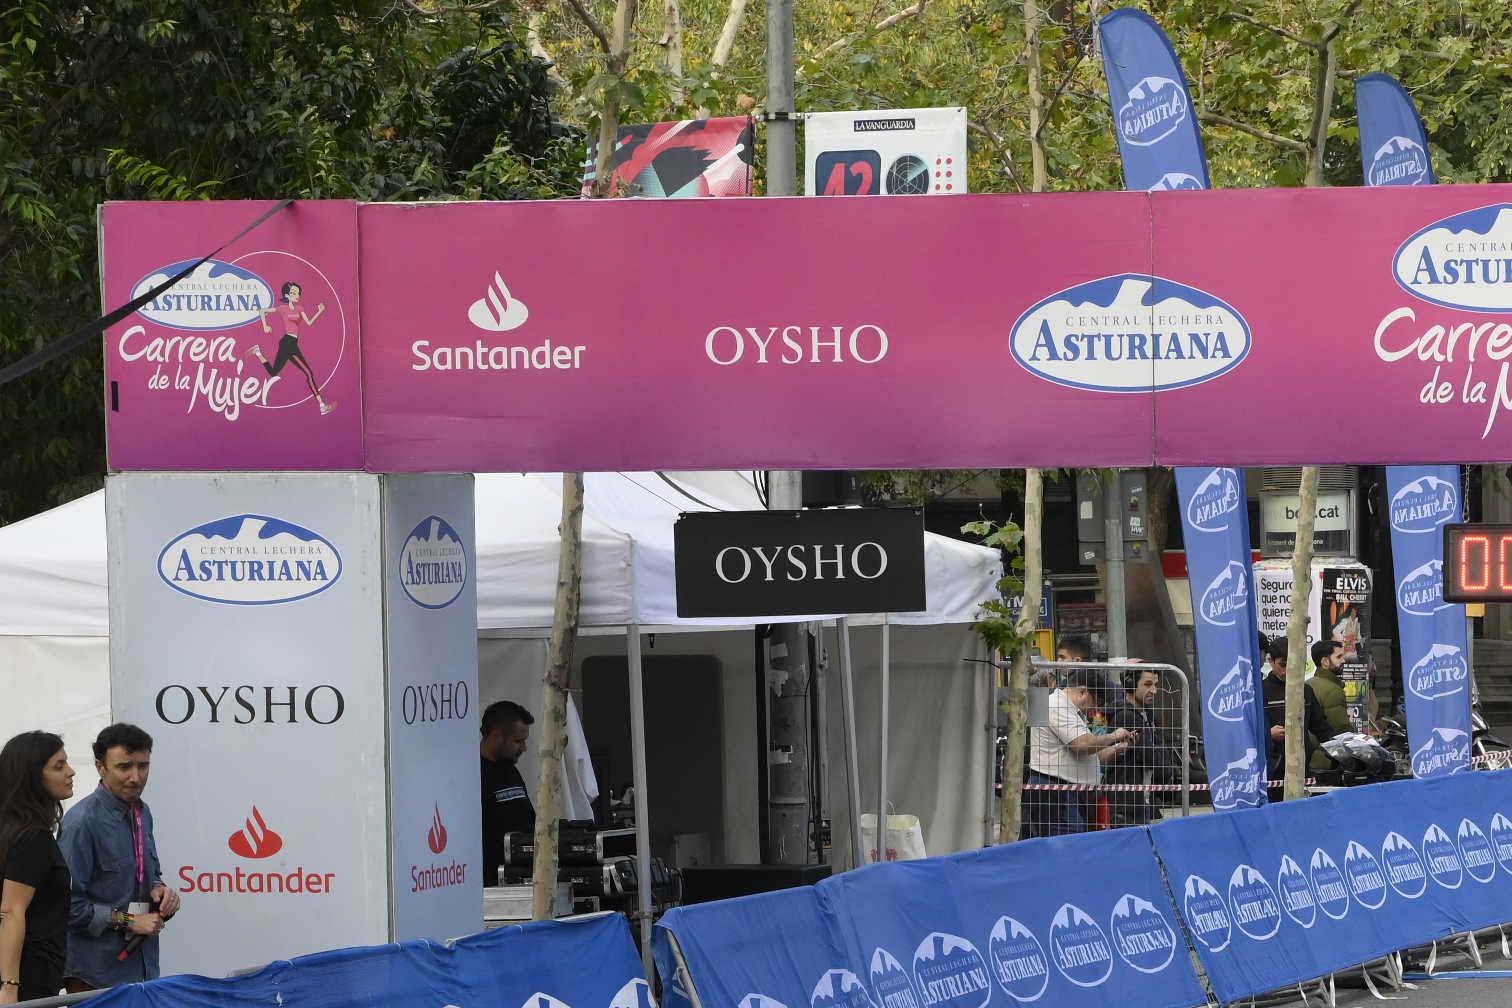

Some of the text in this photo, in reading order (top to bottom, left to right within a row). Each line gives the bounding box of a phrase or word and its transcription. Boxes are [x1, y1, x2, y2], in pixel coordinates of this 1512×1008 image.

[143, 290, 262, 314] ASTURIANA
[1065, 313, 1224, 328] CENTRAL LECHERA
[118, 325, 237, 363] Carrera
[411, 338, 586, 371] Santander
[704, 324, 890, 366] OYSHO
[1028, 319, 1232, 362] ASTURIANA
[148, 360, 281, 422] de la Mujer
[1419, 365, 1454, 405] de
[1461, 364, 1487, 404] la
[172, 547, 329, 583] ASTURIANA
[199, 545, 323, 556] CENTRAL LECHERA
[404, 550, 464, 587] ASTURIANA
[714, 541, 889, 585] OYSHO
[1261, 594, 1275, 606] que
[1336, 577, 1367, 590] ELVIS
[1262, 608, 1293, 618] quiere
[154, 683, 345, 726] OYSHO
[402, 680, 469, 726] OYSHO
[179, 865, 336, 896] Santander
[411, 859, 467, 893] Santander
